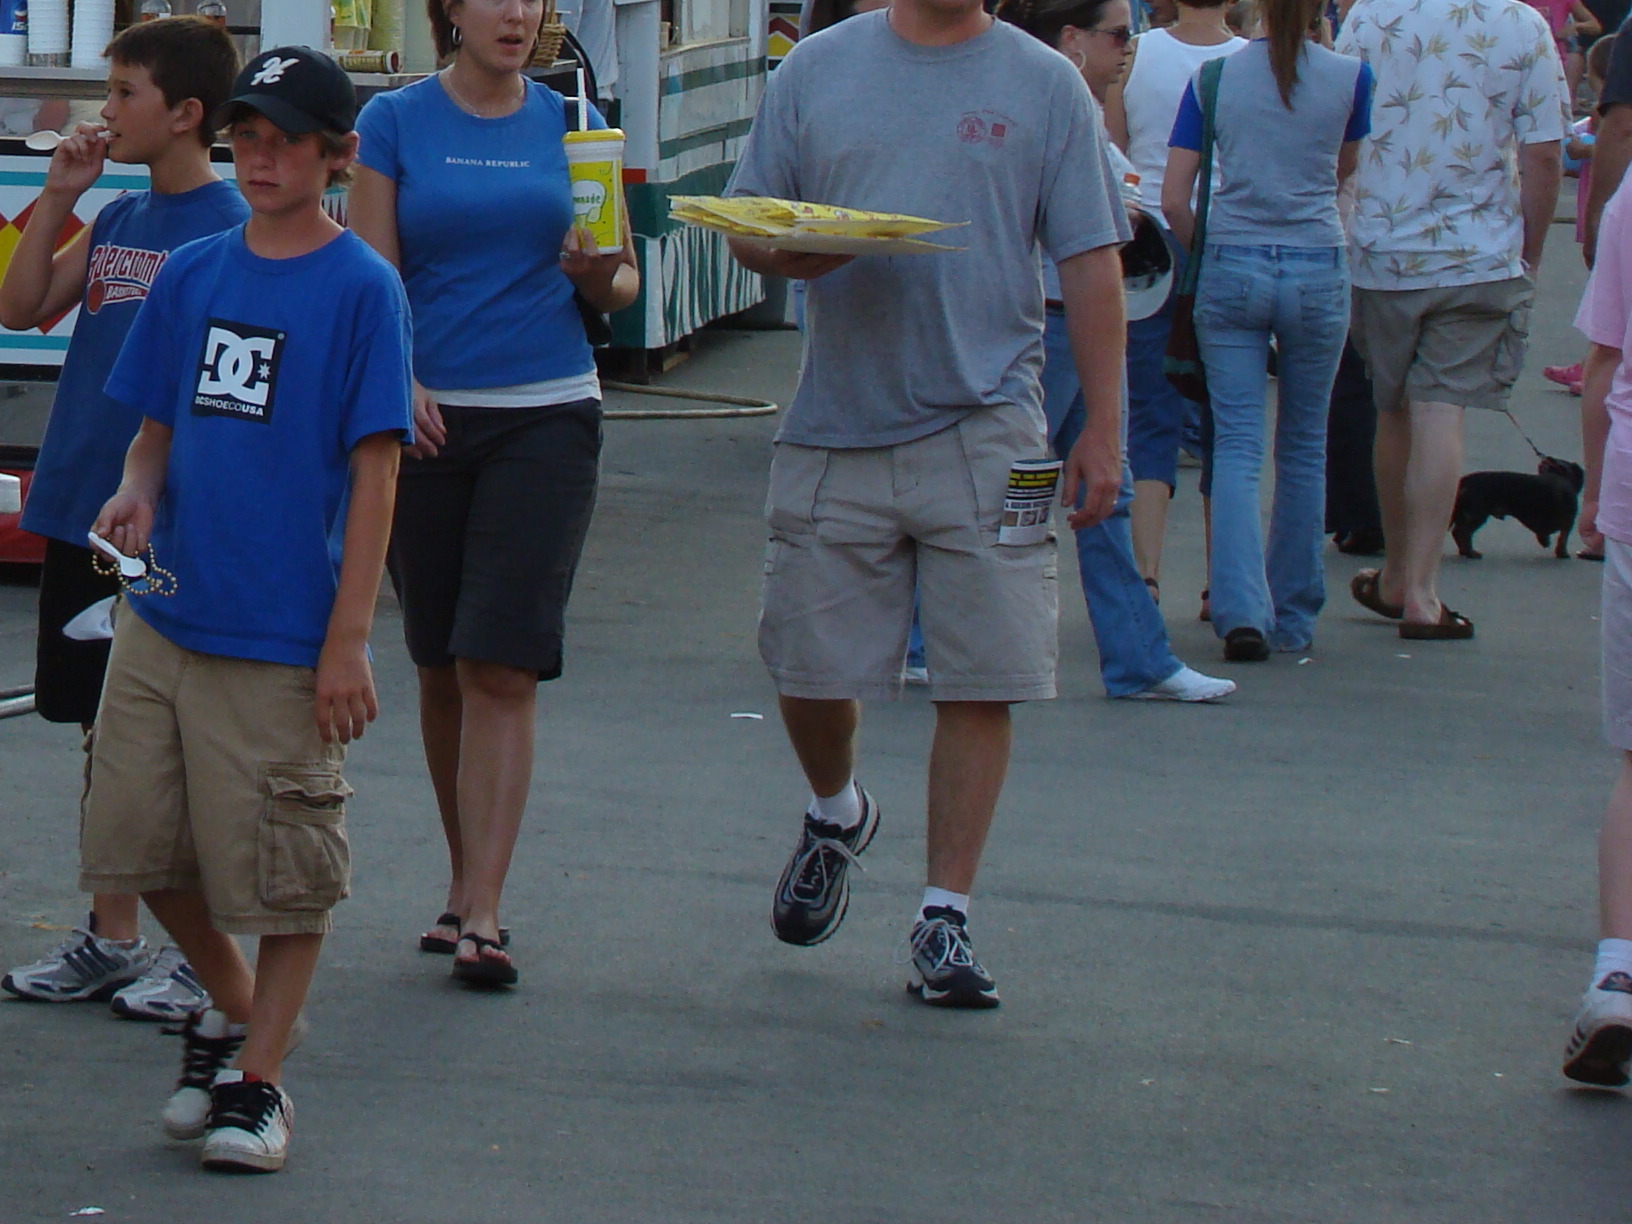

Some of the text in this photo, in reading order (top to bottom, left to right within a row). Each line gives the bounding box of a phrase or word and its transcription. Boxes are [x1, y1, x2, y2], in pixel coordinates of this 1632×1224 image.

[445, 157, 530, 168] BANANA REPUBLIC
[197, 326, 276, 406] DC
